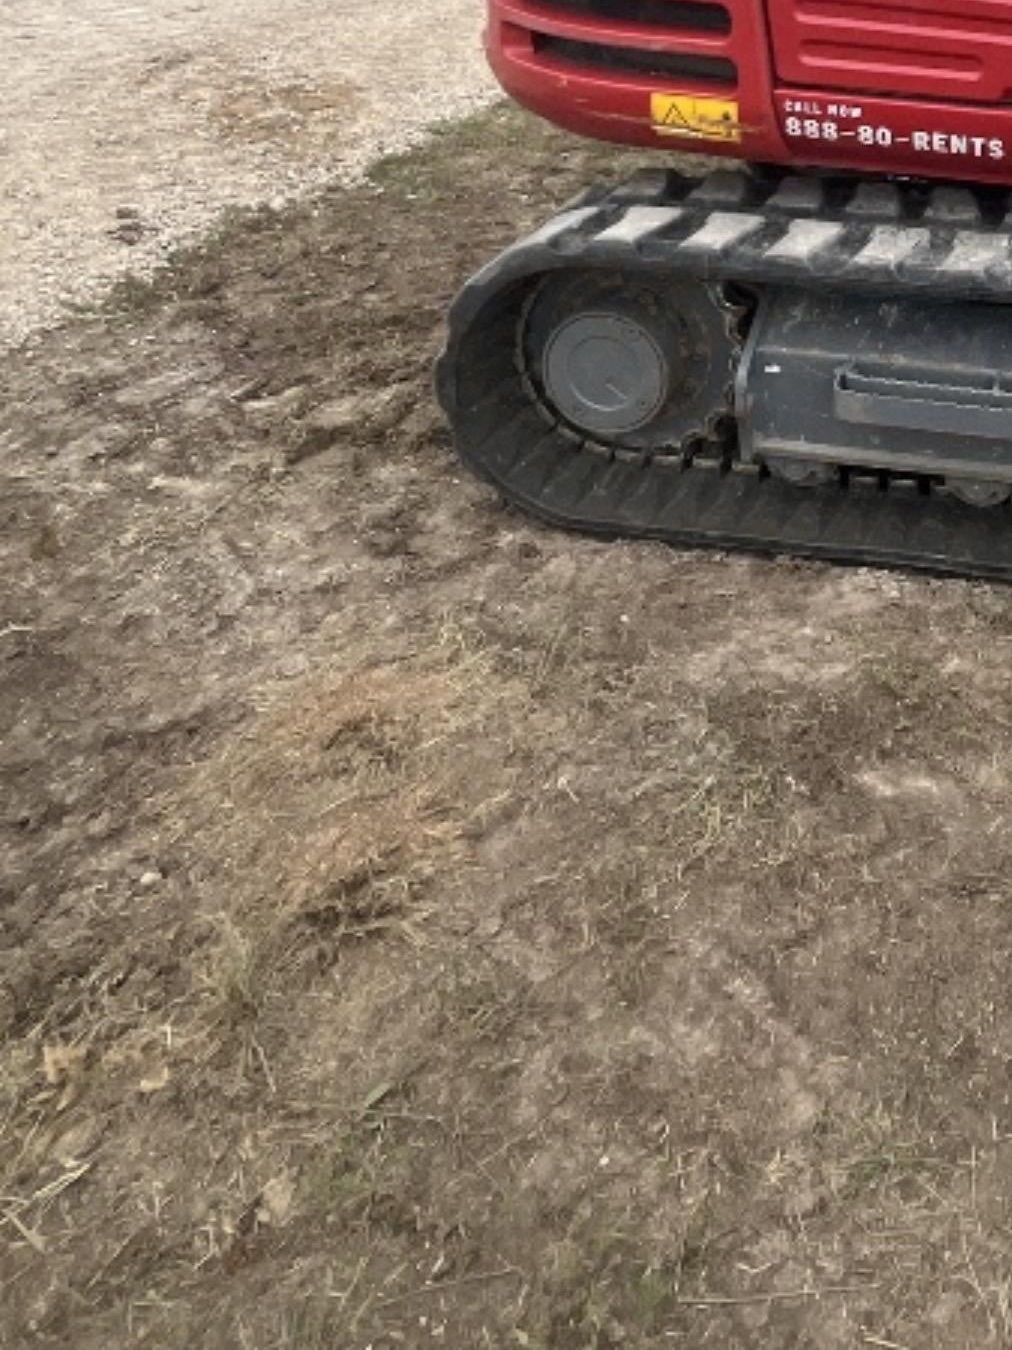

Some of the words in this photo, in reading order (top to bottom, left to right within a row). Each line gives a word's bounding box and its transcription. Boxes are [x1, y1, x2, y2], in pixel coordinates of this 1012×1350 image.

[784, 99, 823, 115] CALL
[827, 104, 862, 118] NOW
[784, 117, 1005, 160] 888-80-RENTS
